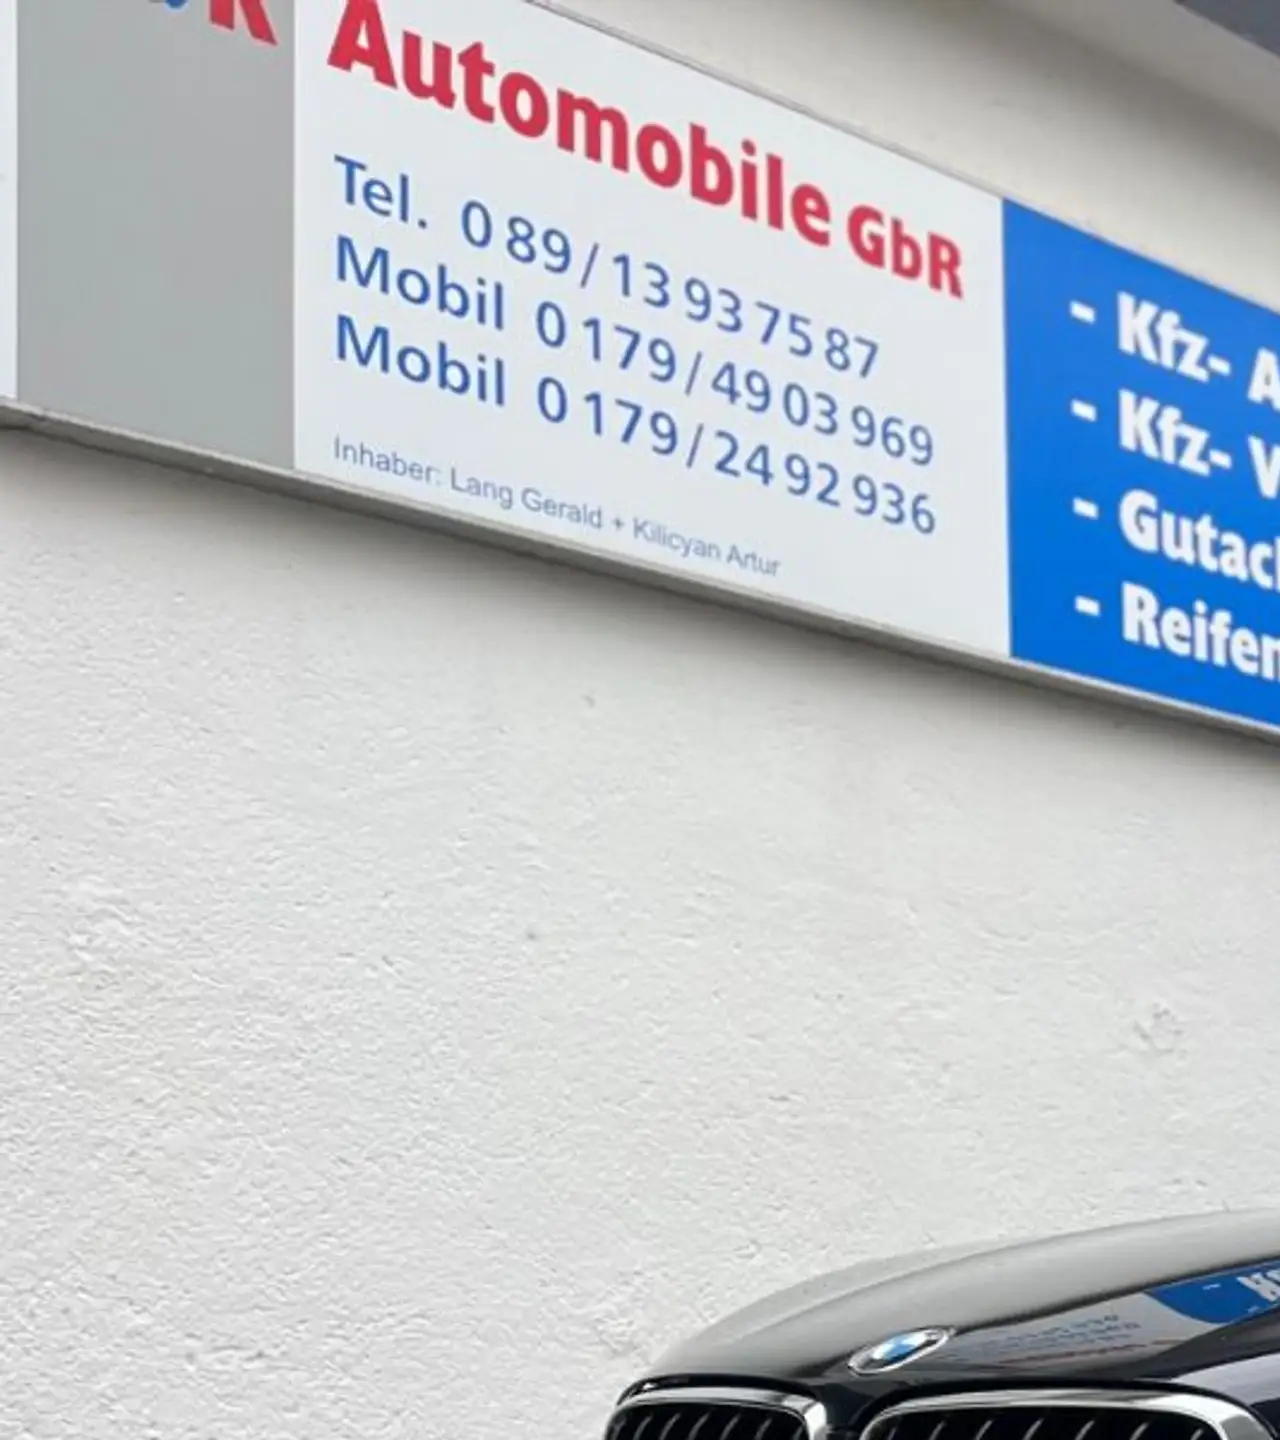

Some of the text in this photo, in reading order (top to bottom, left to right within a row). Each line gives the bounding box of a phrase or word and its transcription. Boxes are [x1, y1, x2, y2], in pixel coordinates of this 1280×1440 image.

[328, 0, 963, 299] Automobile GbR
[334, 155, 428, 229] Tel.
[334, 234, 507, 331] Mobil
[335, 314, 509, 406] Mobil
[1117, 291, 1231, 382] Kfz-
[1118, 389, 1232, 476] Kfz-
[333, 436, 441, 486] Inhaber:
[449, 468, 515, 510] Lang
[520, 487, 604, 530] Gerald
[725, 543, 782, 578] Artur
